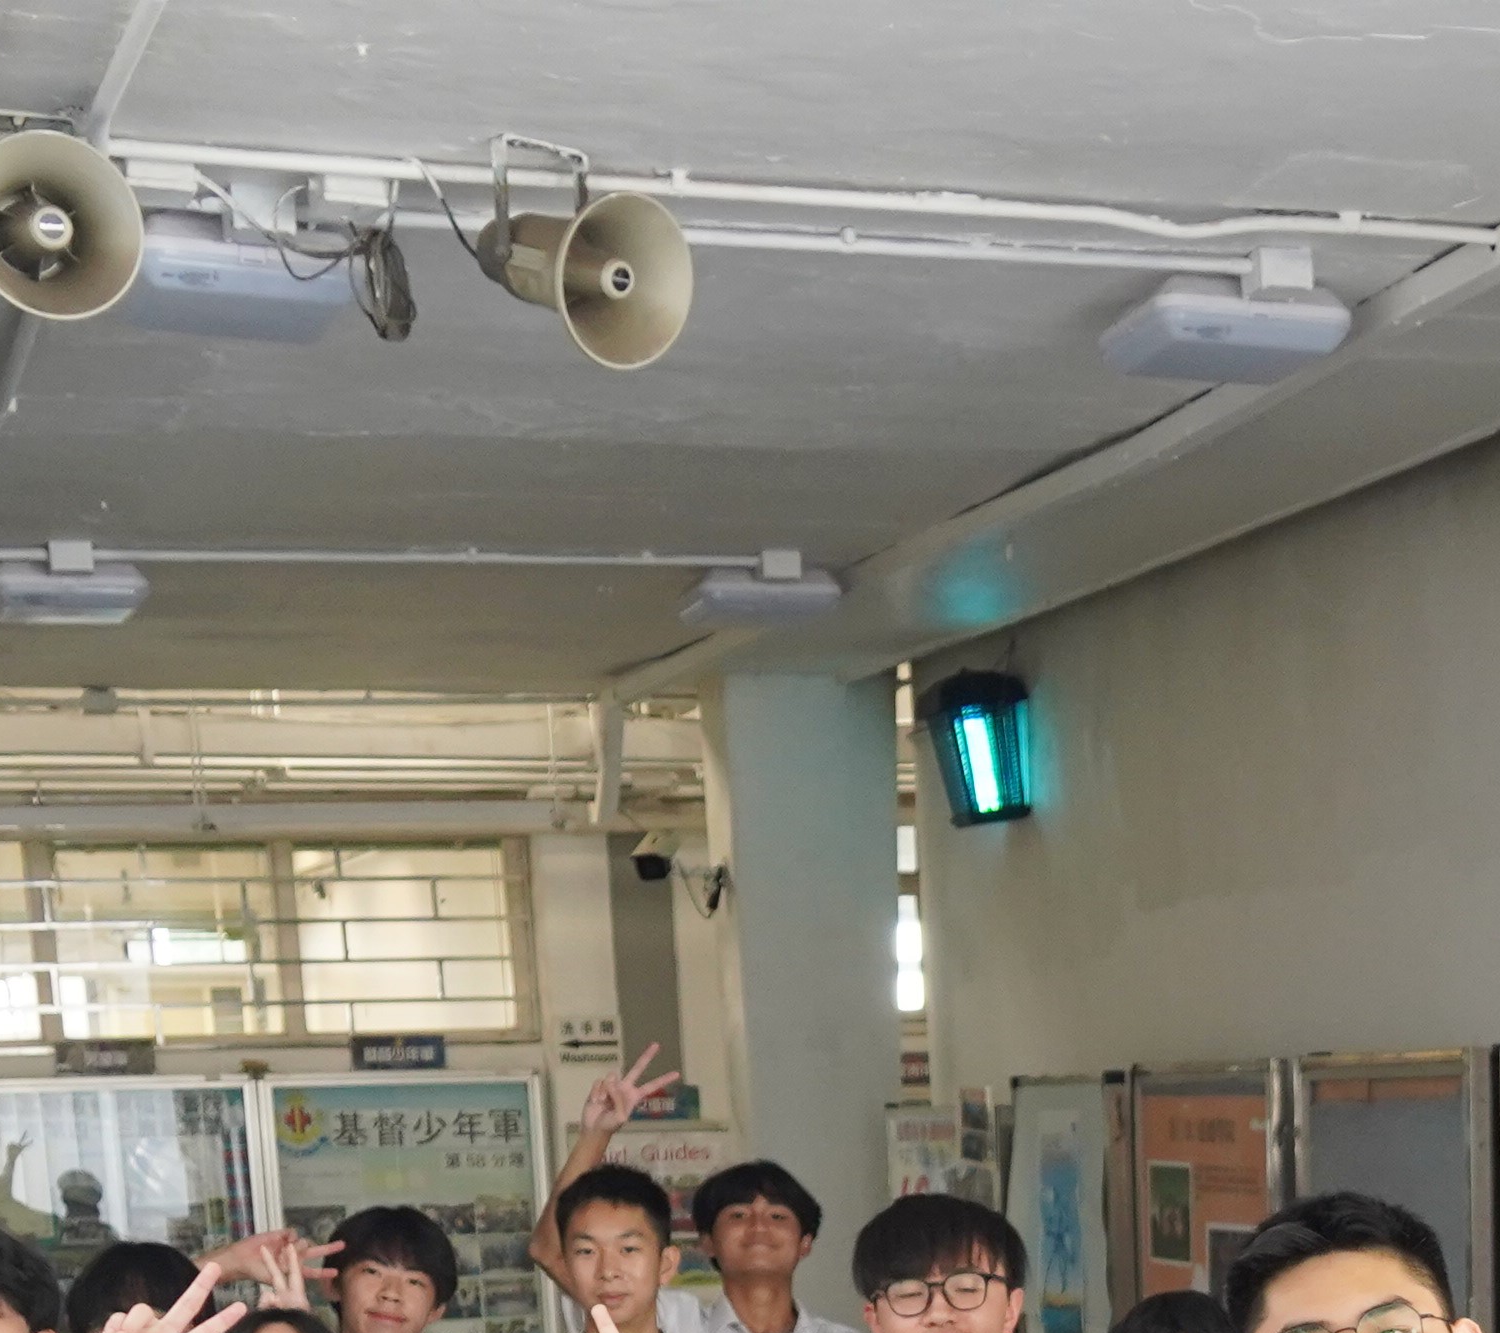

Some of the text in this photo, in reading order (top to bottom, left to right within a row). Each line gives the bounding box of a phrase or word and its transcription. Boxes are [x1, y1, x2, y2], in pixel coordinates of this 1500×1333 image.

[333, 1109, 524, 1146] 基督少年軍
